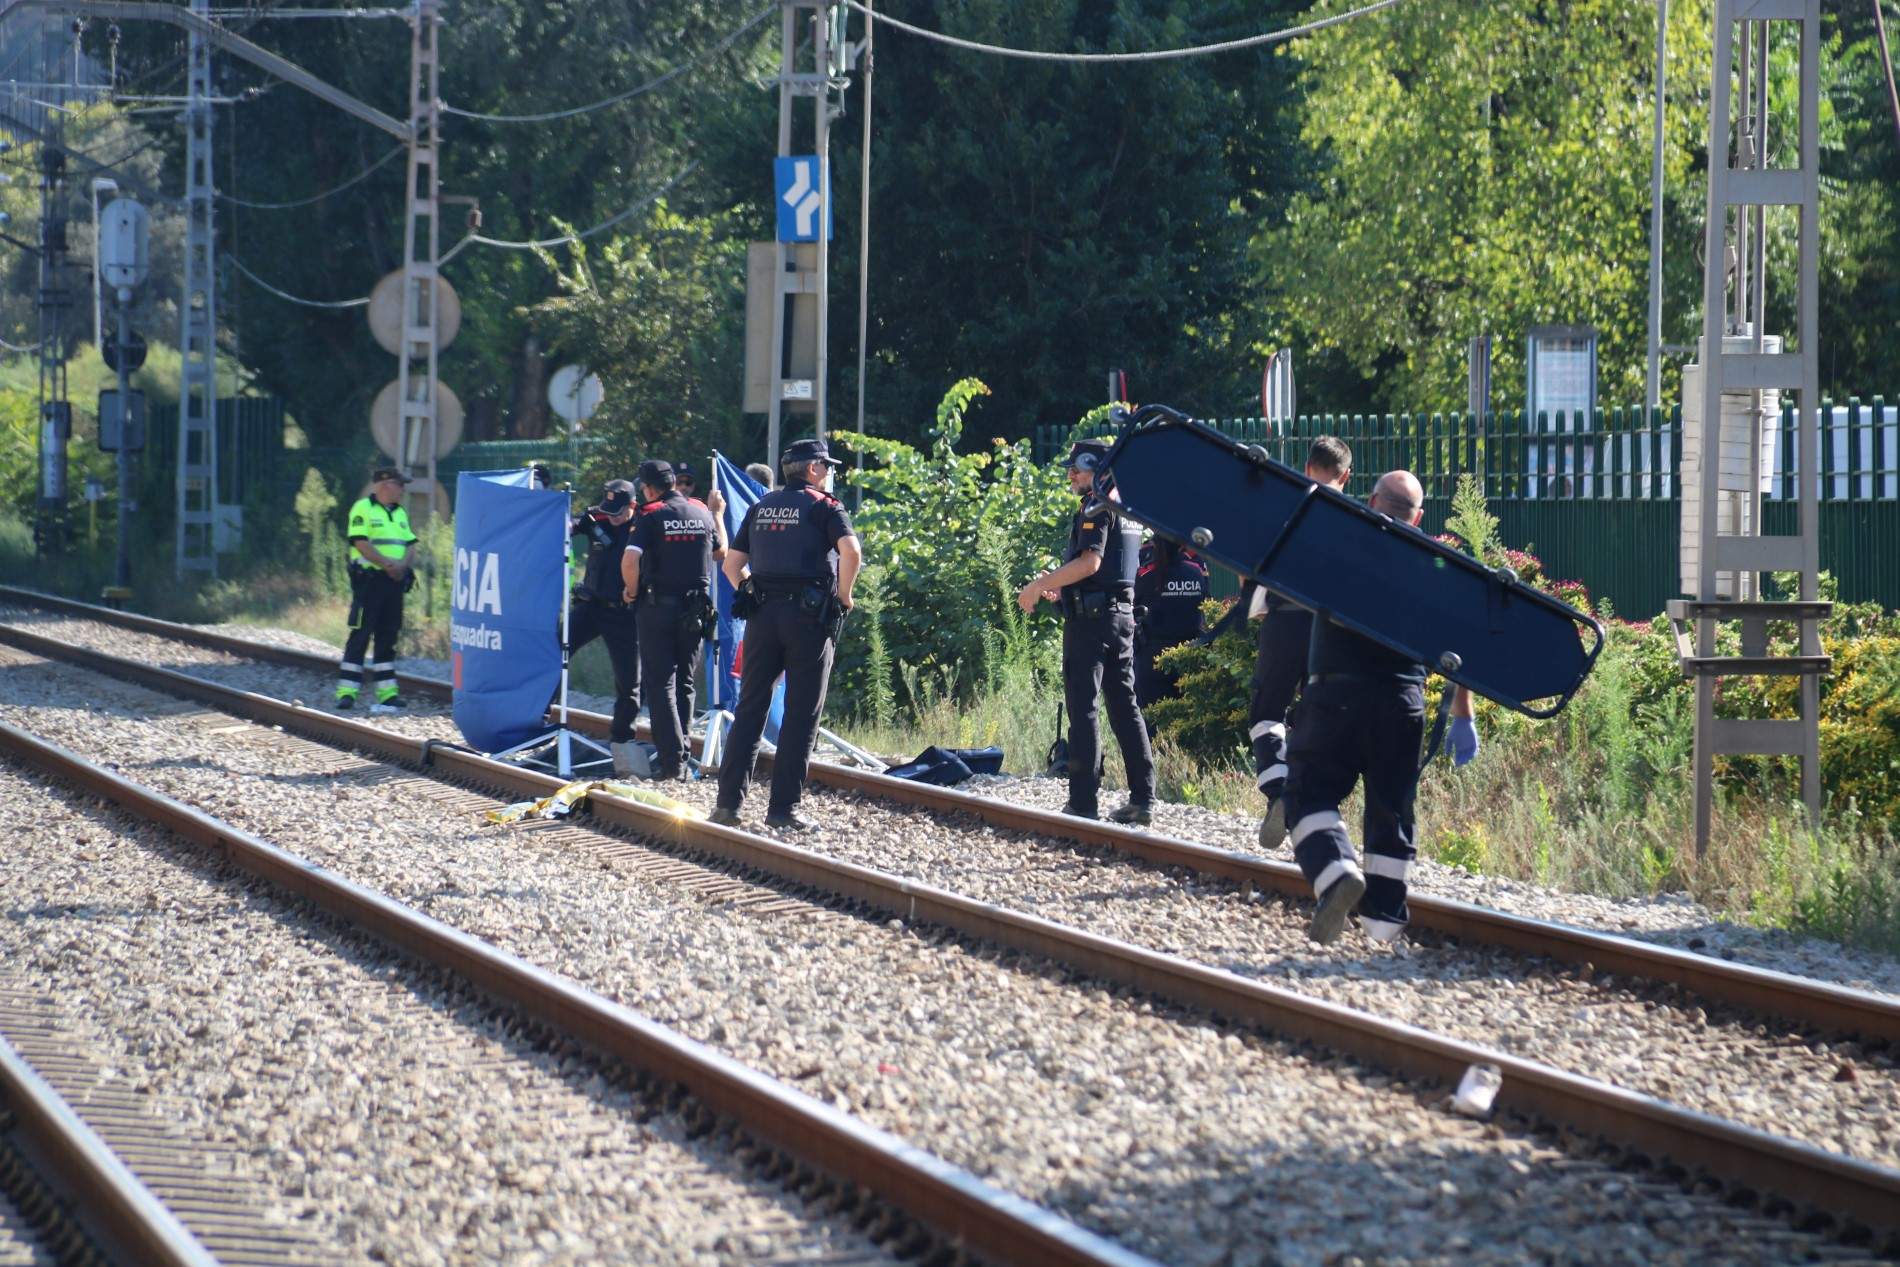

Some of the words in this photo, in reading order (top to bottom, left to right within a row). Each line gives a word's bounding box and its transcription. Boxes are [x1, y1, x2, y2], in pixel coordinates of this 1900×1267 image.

[757, 507, 800, 518] POLICIA
[663, 519, 705, 530] POLICIA
[1167, 581, 1202, 591] OLICIA
